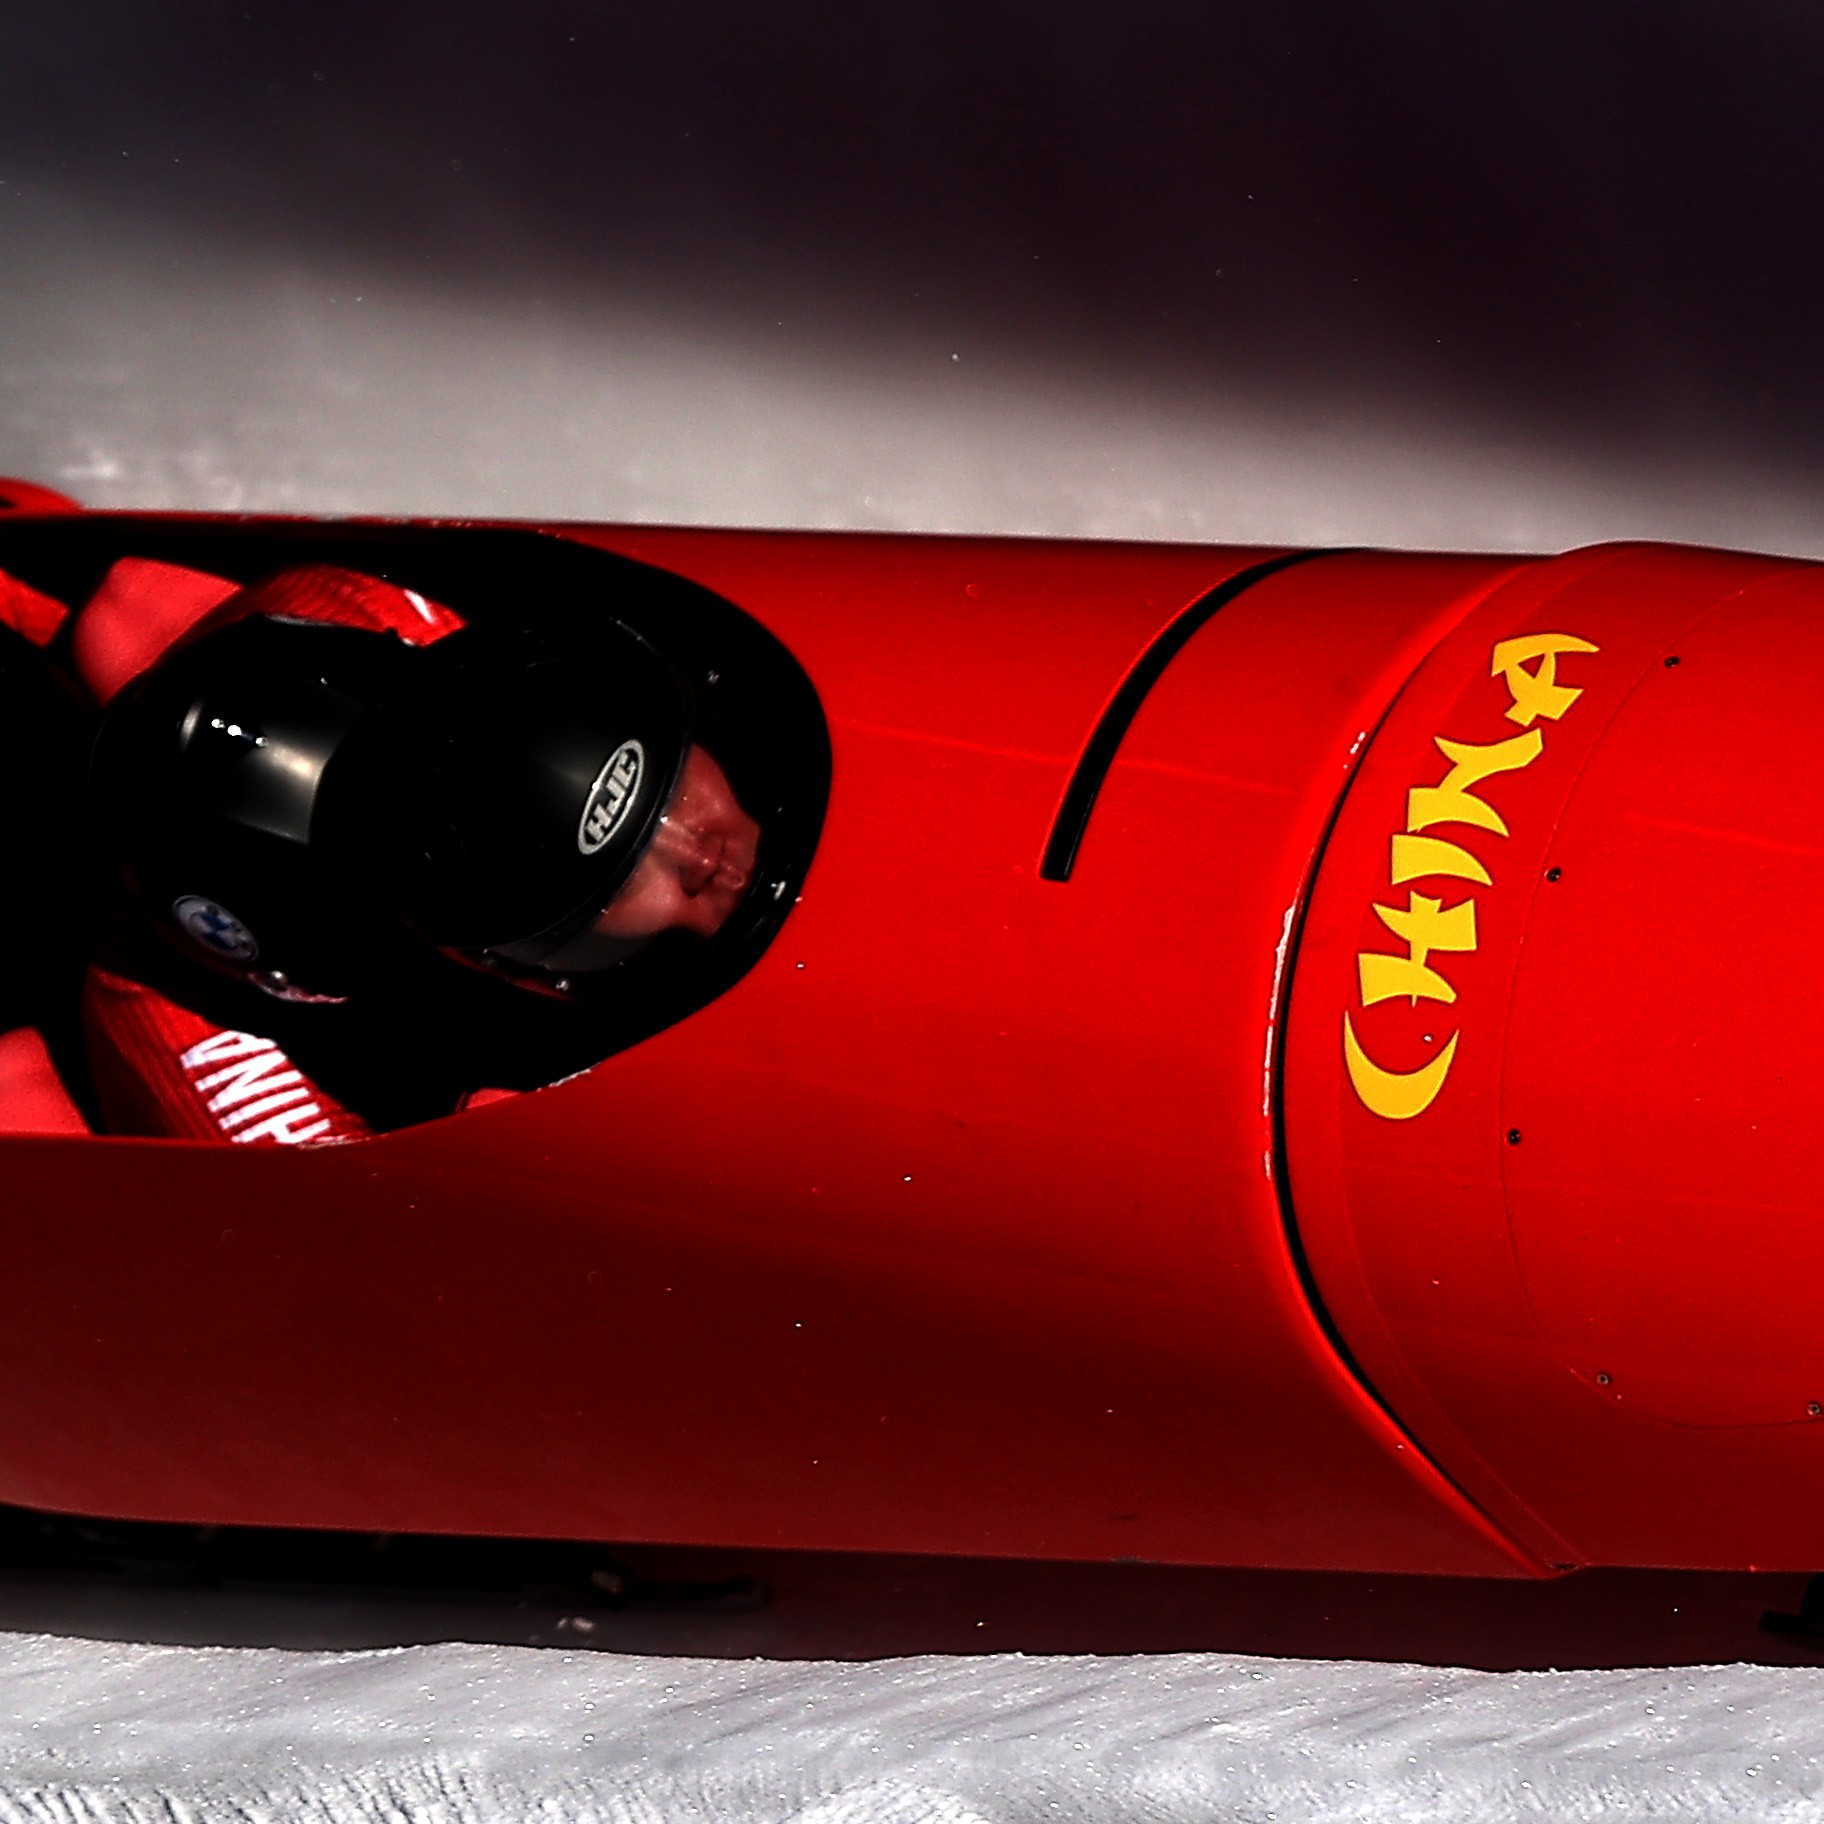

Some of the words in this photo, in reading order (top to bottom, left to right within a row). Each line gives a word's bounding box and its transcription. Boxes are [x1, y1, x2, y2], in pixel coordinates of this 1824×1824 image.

[585, 750, 637, 841] HJC
[1342, 633, 1600, 1120] CHINA
[179, 1029, 348, 1147] HINA
